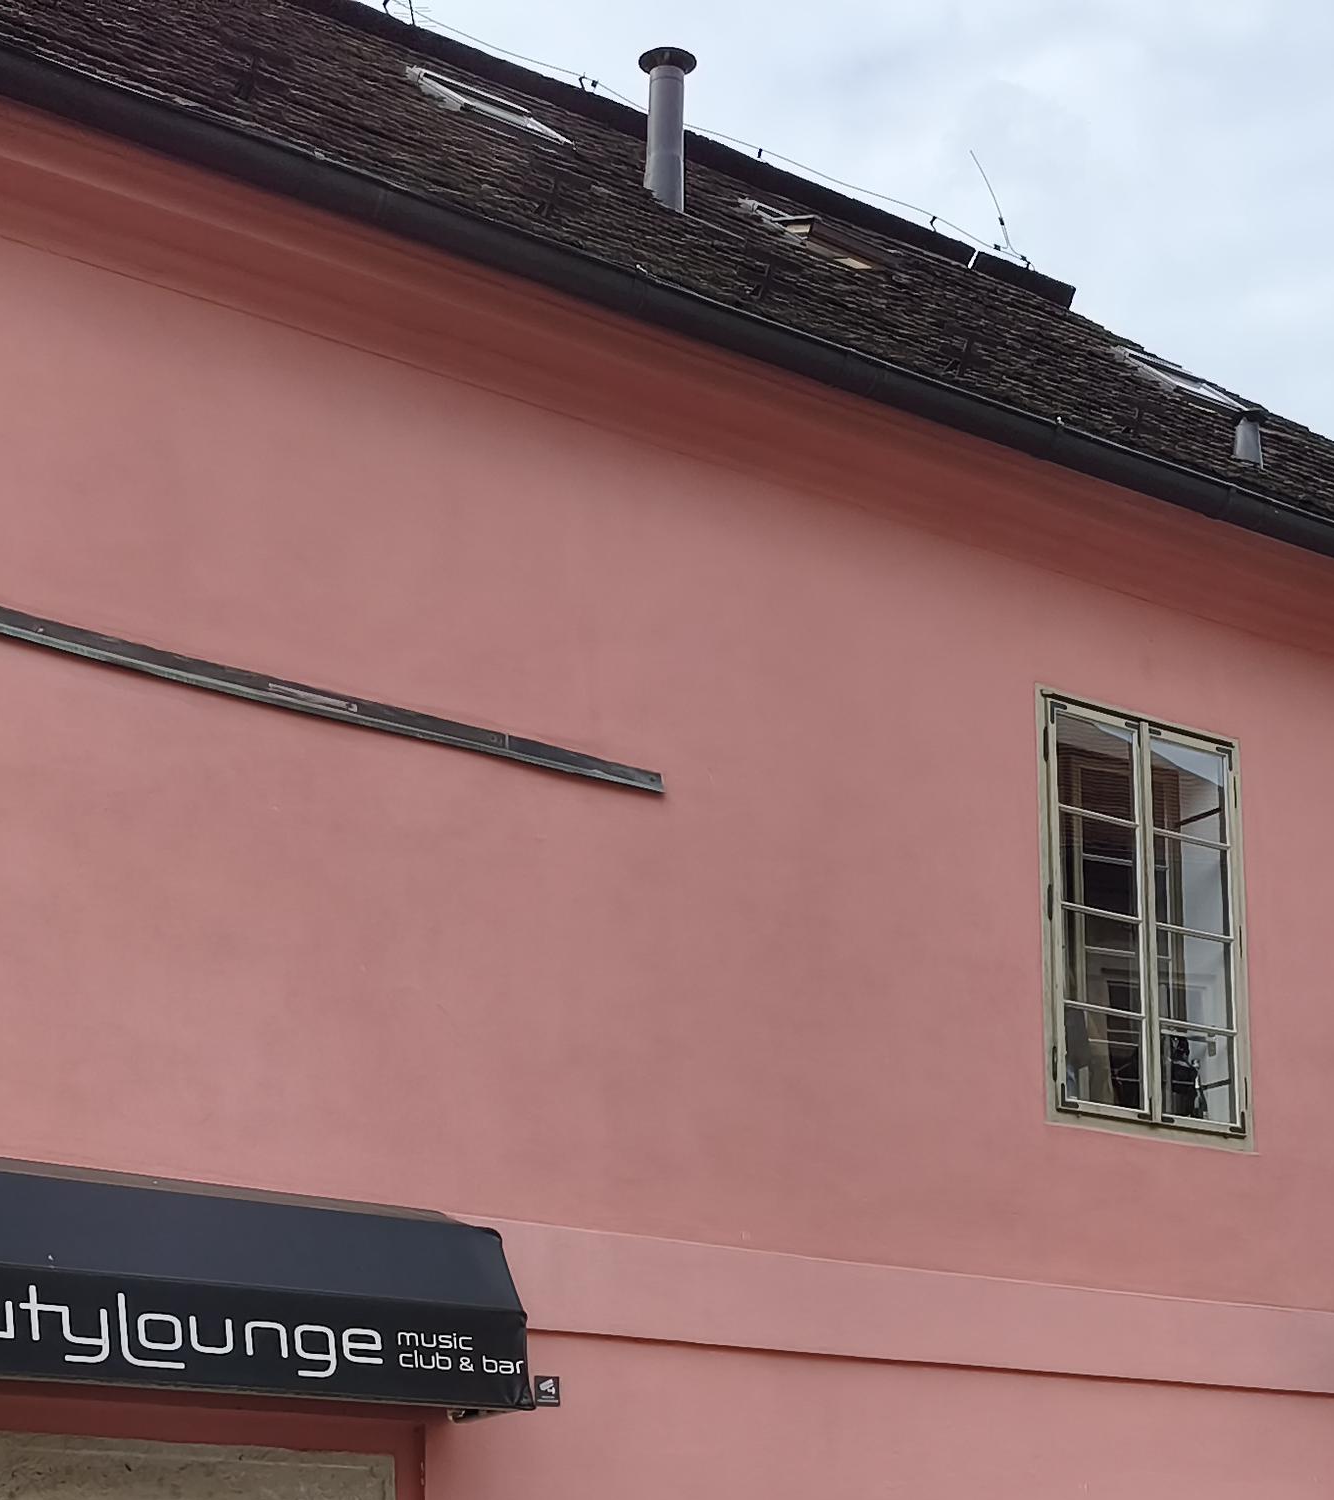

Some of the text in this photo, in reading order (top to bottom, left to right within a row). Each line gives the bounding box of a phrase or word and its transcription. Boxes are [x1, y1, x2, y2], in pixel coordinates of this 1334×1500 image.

[397, 1331, 473, 1351] music
[399, 1350, 525, 1375] club & bar
